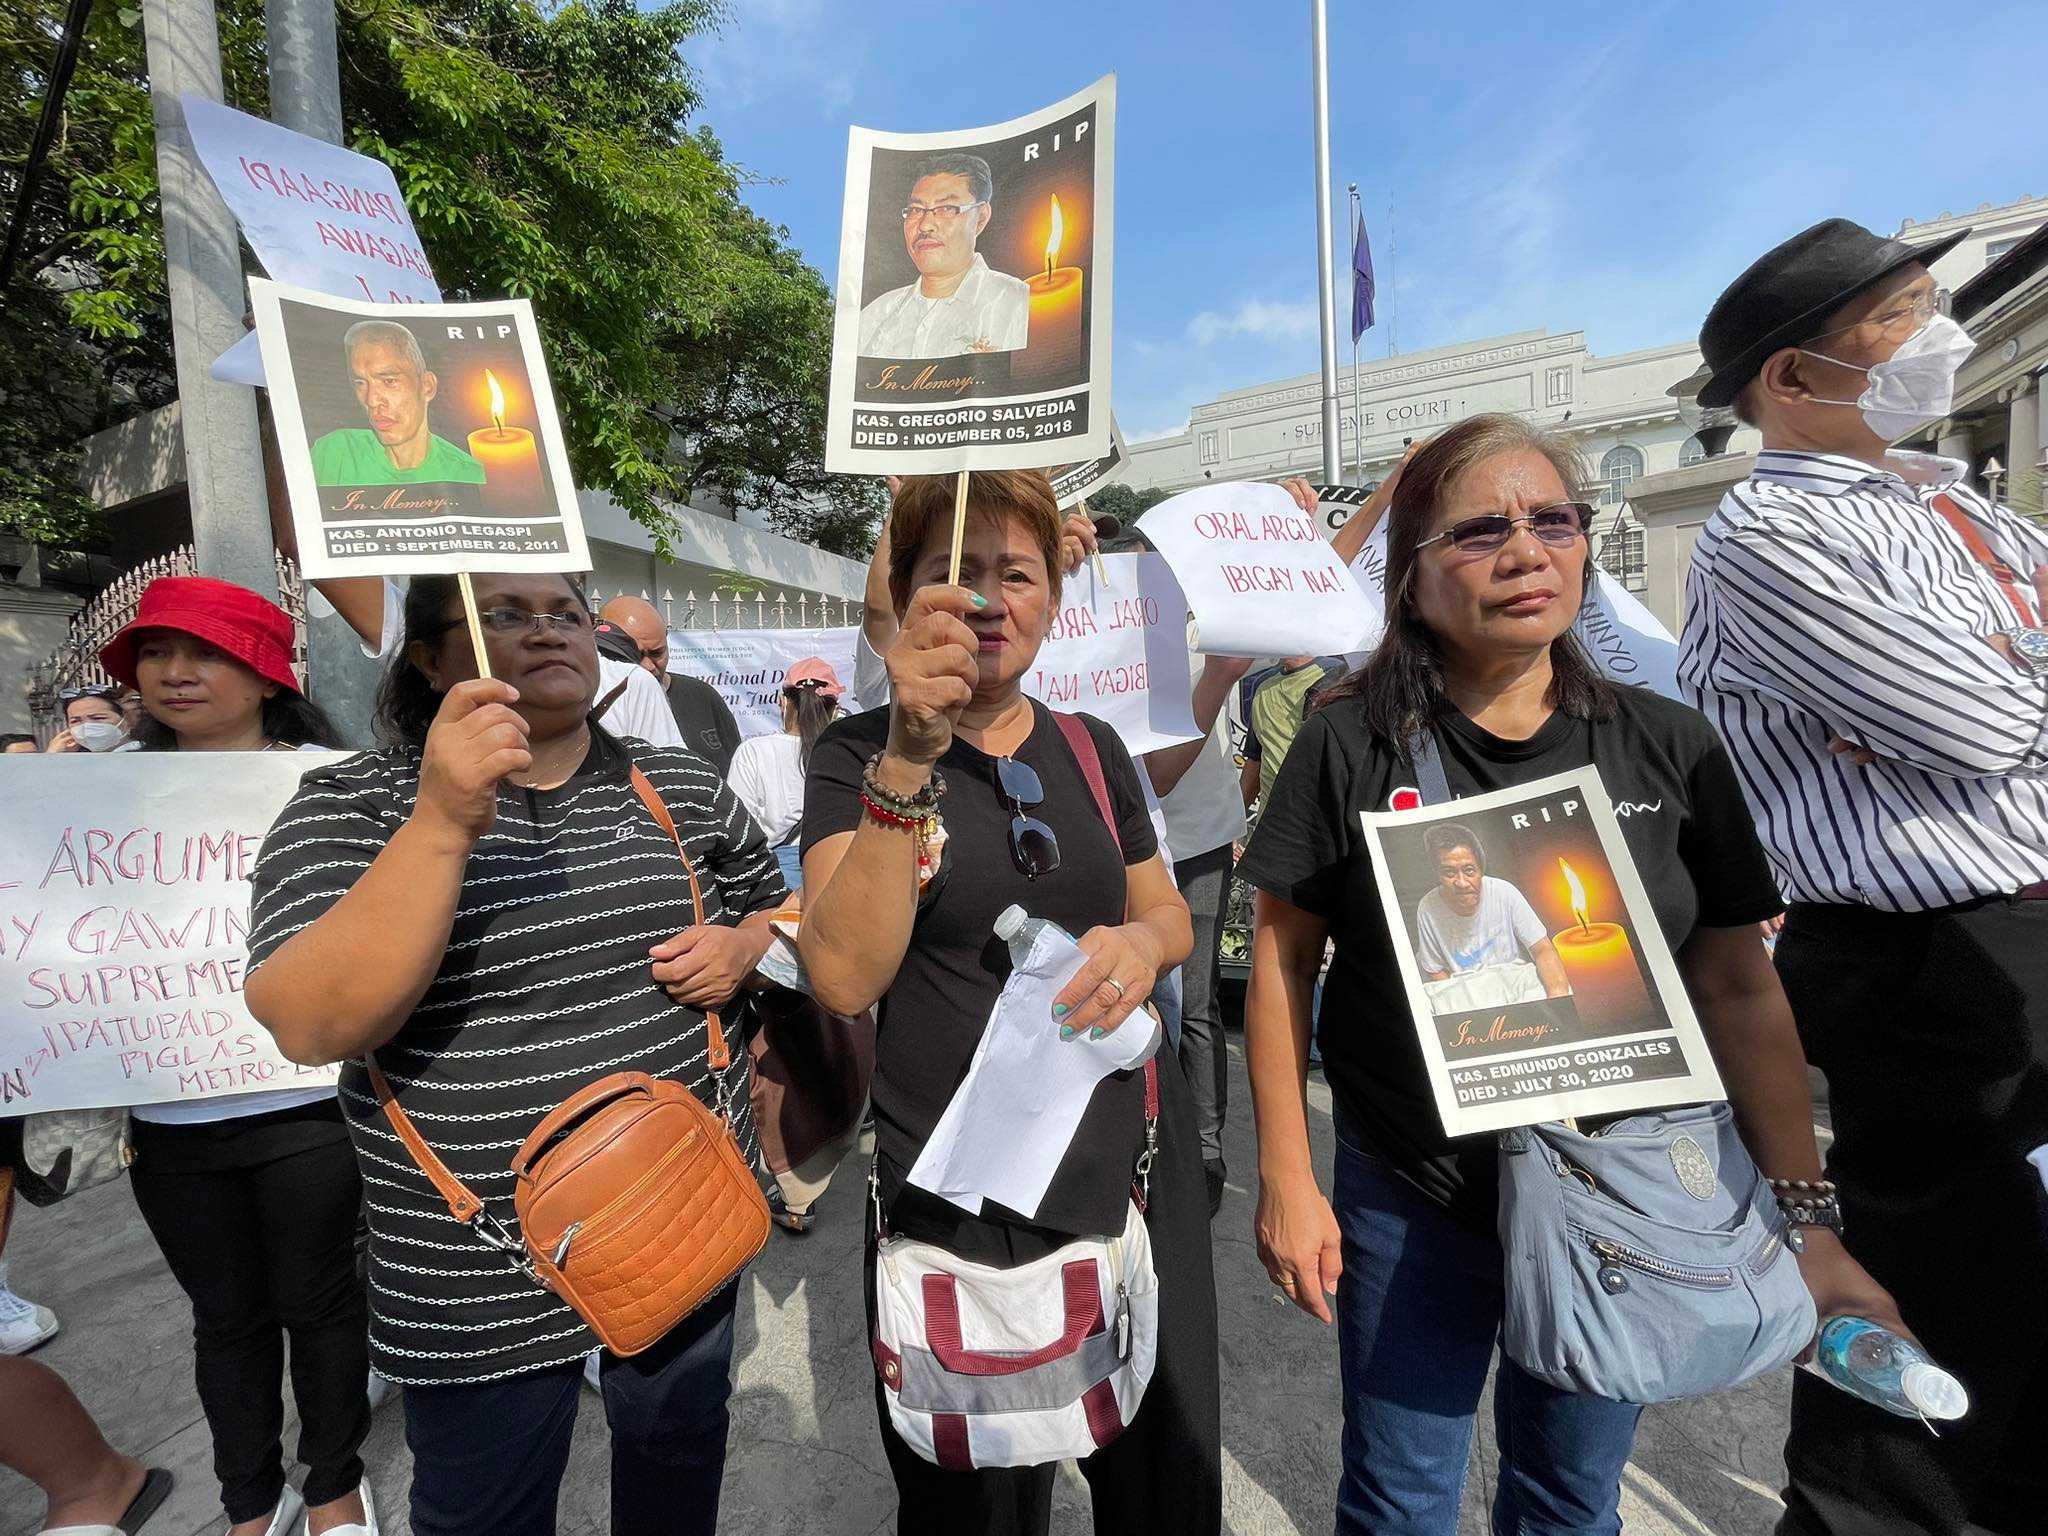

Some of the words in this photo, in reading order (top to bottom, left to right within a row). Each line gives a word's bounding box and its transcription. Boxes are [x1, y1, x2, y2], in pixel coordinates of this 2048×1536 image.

[865, 364, 902, 391] In
[856, 414, 894, 427] KAS.
[898, 409, 988, 427] GREGORIO
[991, 399, 1076, 421] SALVEDIA
[1386, 399, 1451, 422] COURT
[855, 431, 899, 446] DIED
[913, 428, 1002, 446] NOVEMBER
[1005, 425, 1031, 441] 05,
[1034, 420, 1073, 436] 2018
[331, 489, 367, 511] In
[328, 529, 370, 541] KAS.
[376, 525, 457, 538] ANTONIO
[462, 525, 532, 537] LEGASPI
[1194, 511, 1258, 541] ORAL
[331, 542, 379, 554] DIED
[396, 539, 495, 553] SEPTEMBER
[498, 541, 521, 552] 28,
[525, 540, 559, 551] 2011
[1220, 564, 1294, 594] IBIGAY
[1302, 566, 1345, 594] NA!
[23, 959, 245, 1010] SUPREME
[41, 1009, 234, 1059] IPATUPAD
[1449, 1018, 1478, 1048] In
[117, 1034, 257, 1079] PIGLAS
[1452, 1069, 1488, 1085] KAS.
[1489, 1055, 1571, 1079] EDMUNDO
[1573, 1041, 1671, 1066] GONZALES
[1457, 1086, 1498, 1103] DIED
[1511, 1076, 1554, 1095] JULY
[1558, 1071, 1588, 1089] 30,
[1590, 1064, 1635, 1083] 2020
